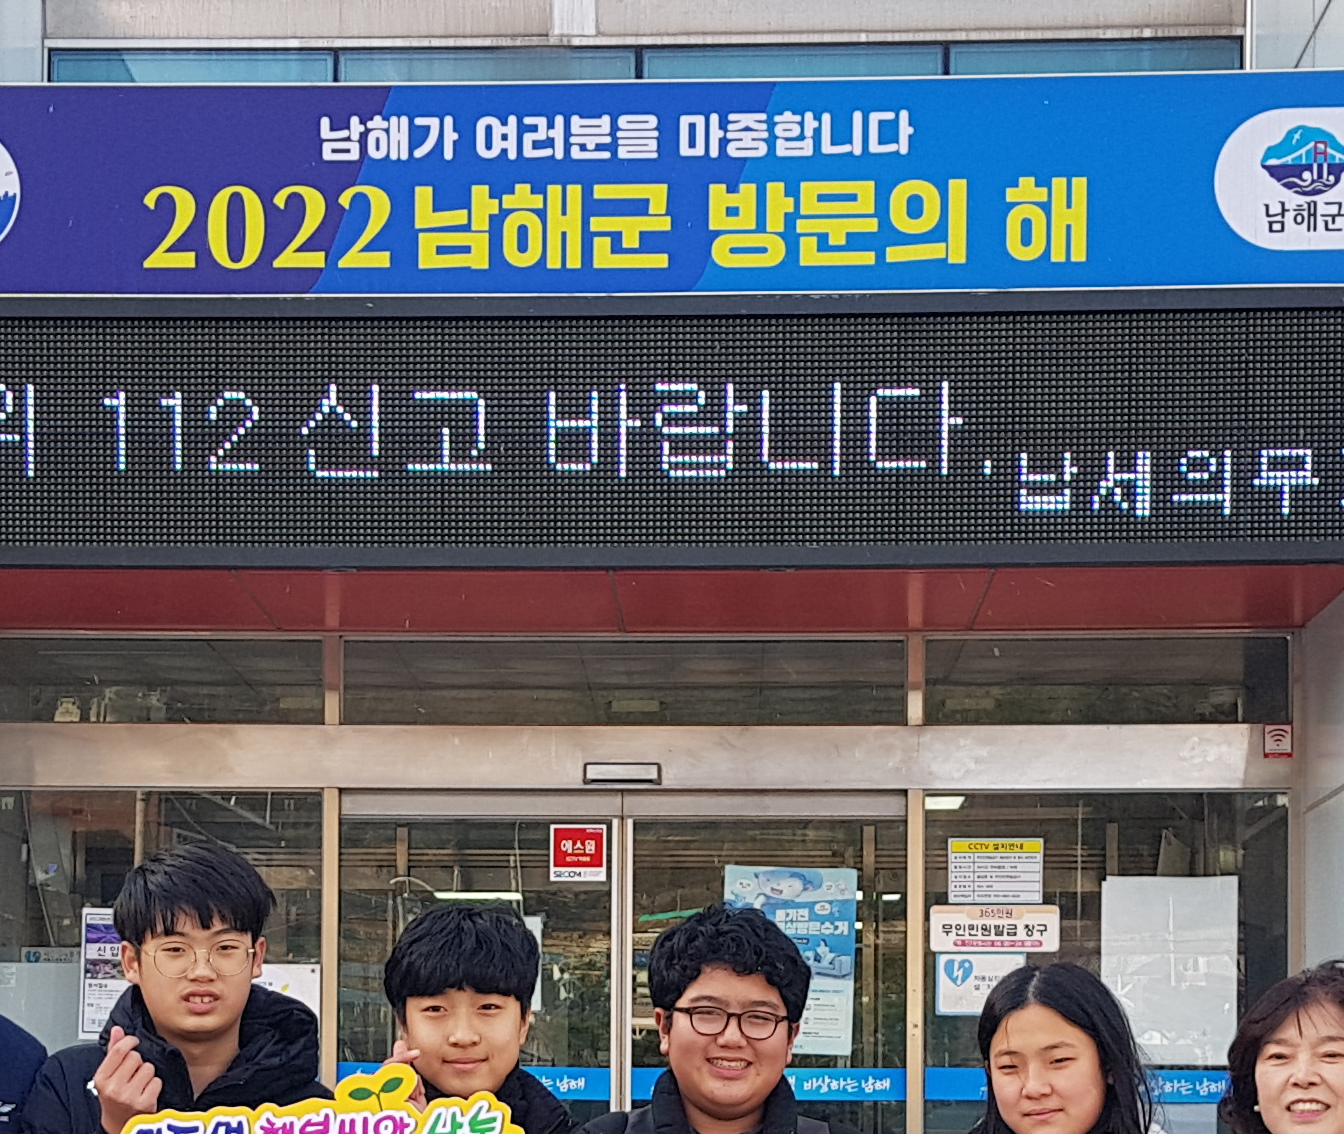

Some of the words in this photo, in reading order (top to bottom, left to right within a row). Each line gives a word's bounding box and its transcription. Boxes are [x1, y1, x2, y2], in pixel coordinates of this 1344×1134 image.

[319, 115, 459, 162] 남해가
[476, 112, 659, 160] 여러분을
[679, 109, 915, 158] 마중합니다
[142, 184, 391, 269] 2022
[414, 182, 671, 269] 남해군
[708, 178, 967, 268] 방문의
[1005, 176, 1087, 263] 해
[103, 390, 259, 472] 112
[300, 383, 492, 478] 신고
[968, 842, 990, 851] CCTV
[942, 923, 1018, 937] 무인민원발급
[1023, 923, 1048, 937] 창구
[556, 1075, 586, 1093] 남해
[803, 1074, 860, 1095] 비상하는
[862, 1075, 892, 1093] 남해
